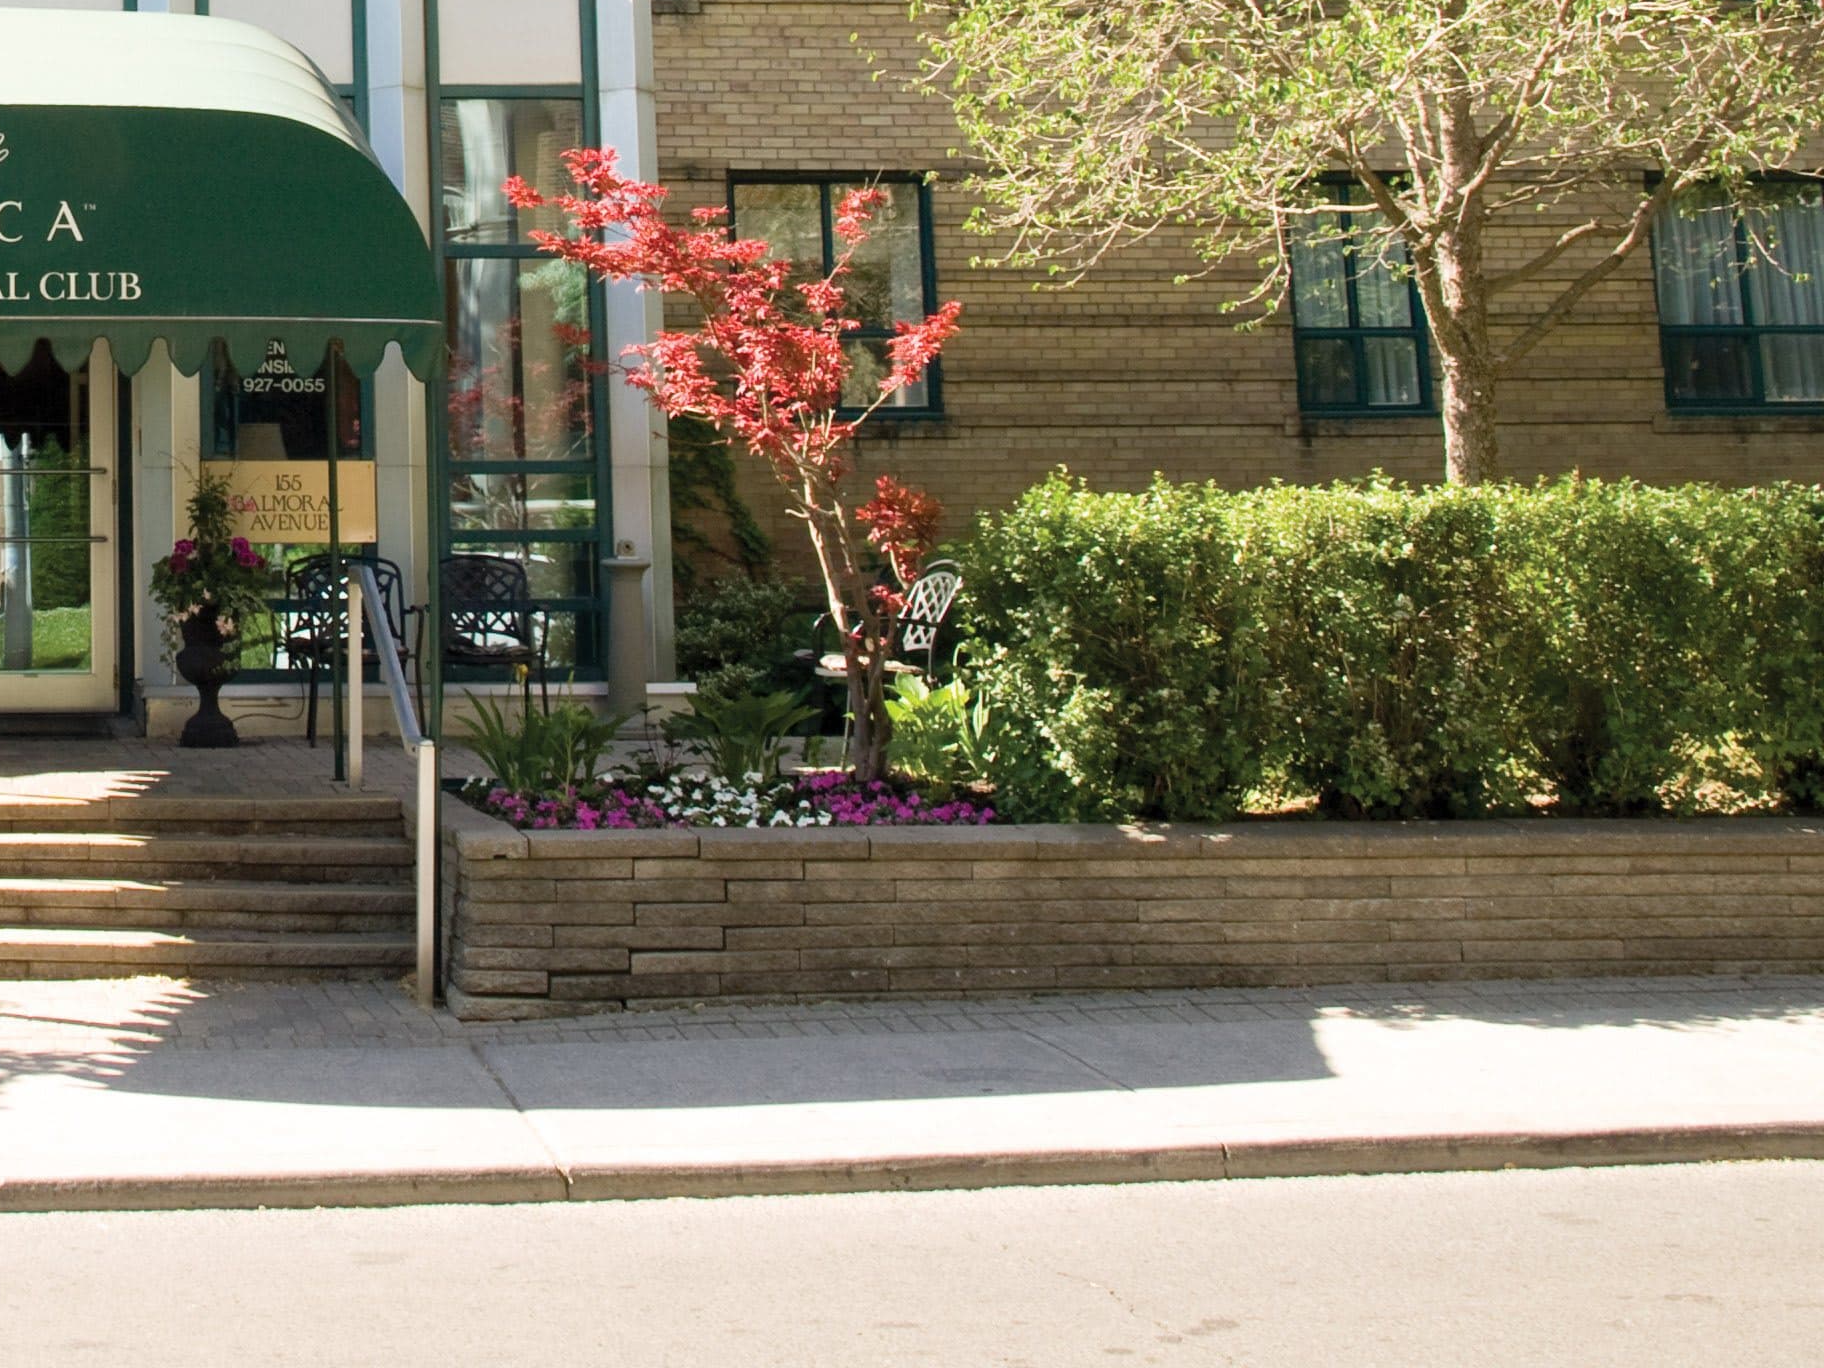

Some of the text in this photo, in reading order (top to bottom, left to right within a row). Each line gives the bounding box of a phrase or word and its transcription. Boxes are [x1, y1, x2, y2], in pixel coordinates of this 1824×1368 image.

[39, 272, 142, 300] CLUB
[243, 378, 326, 392] 927-0055
[275, 474, 303, 491] 155
[250, 514, 329, 531] AVENUE
